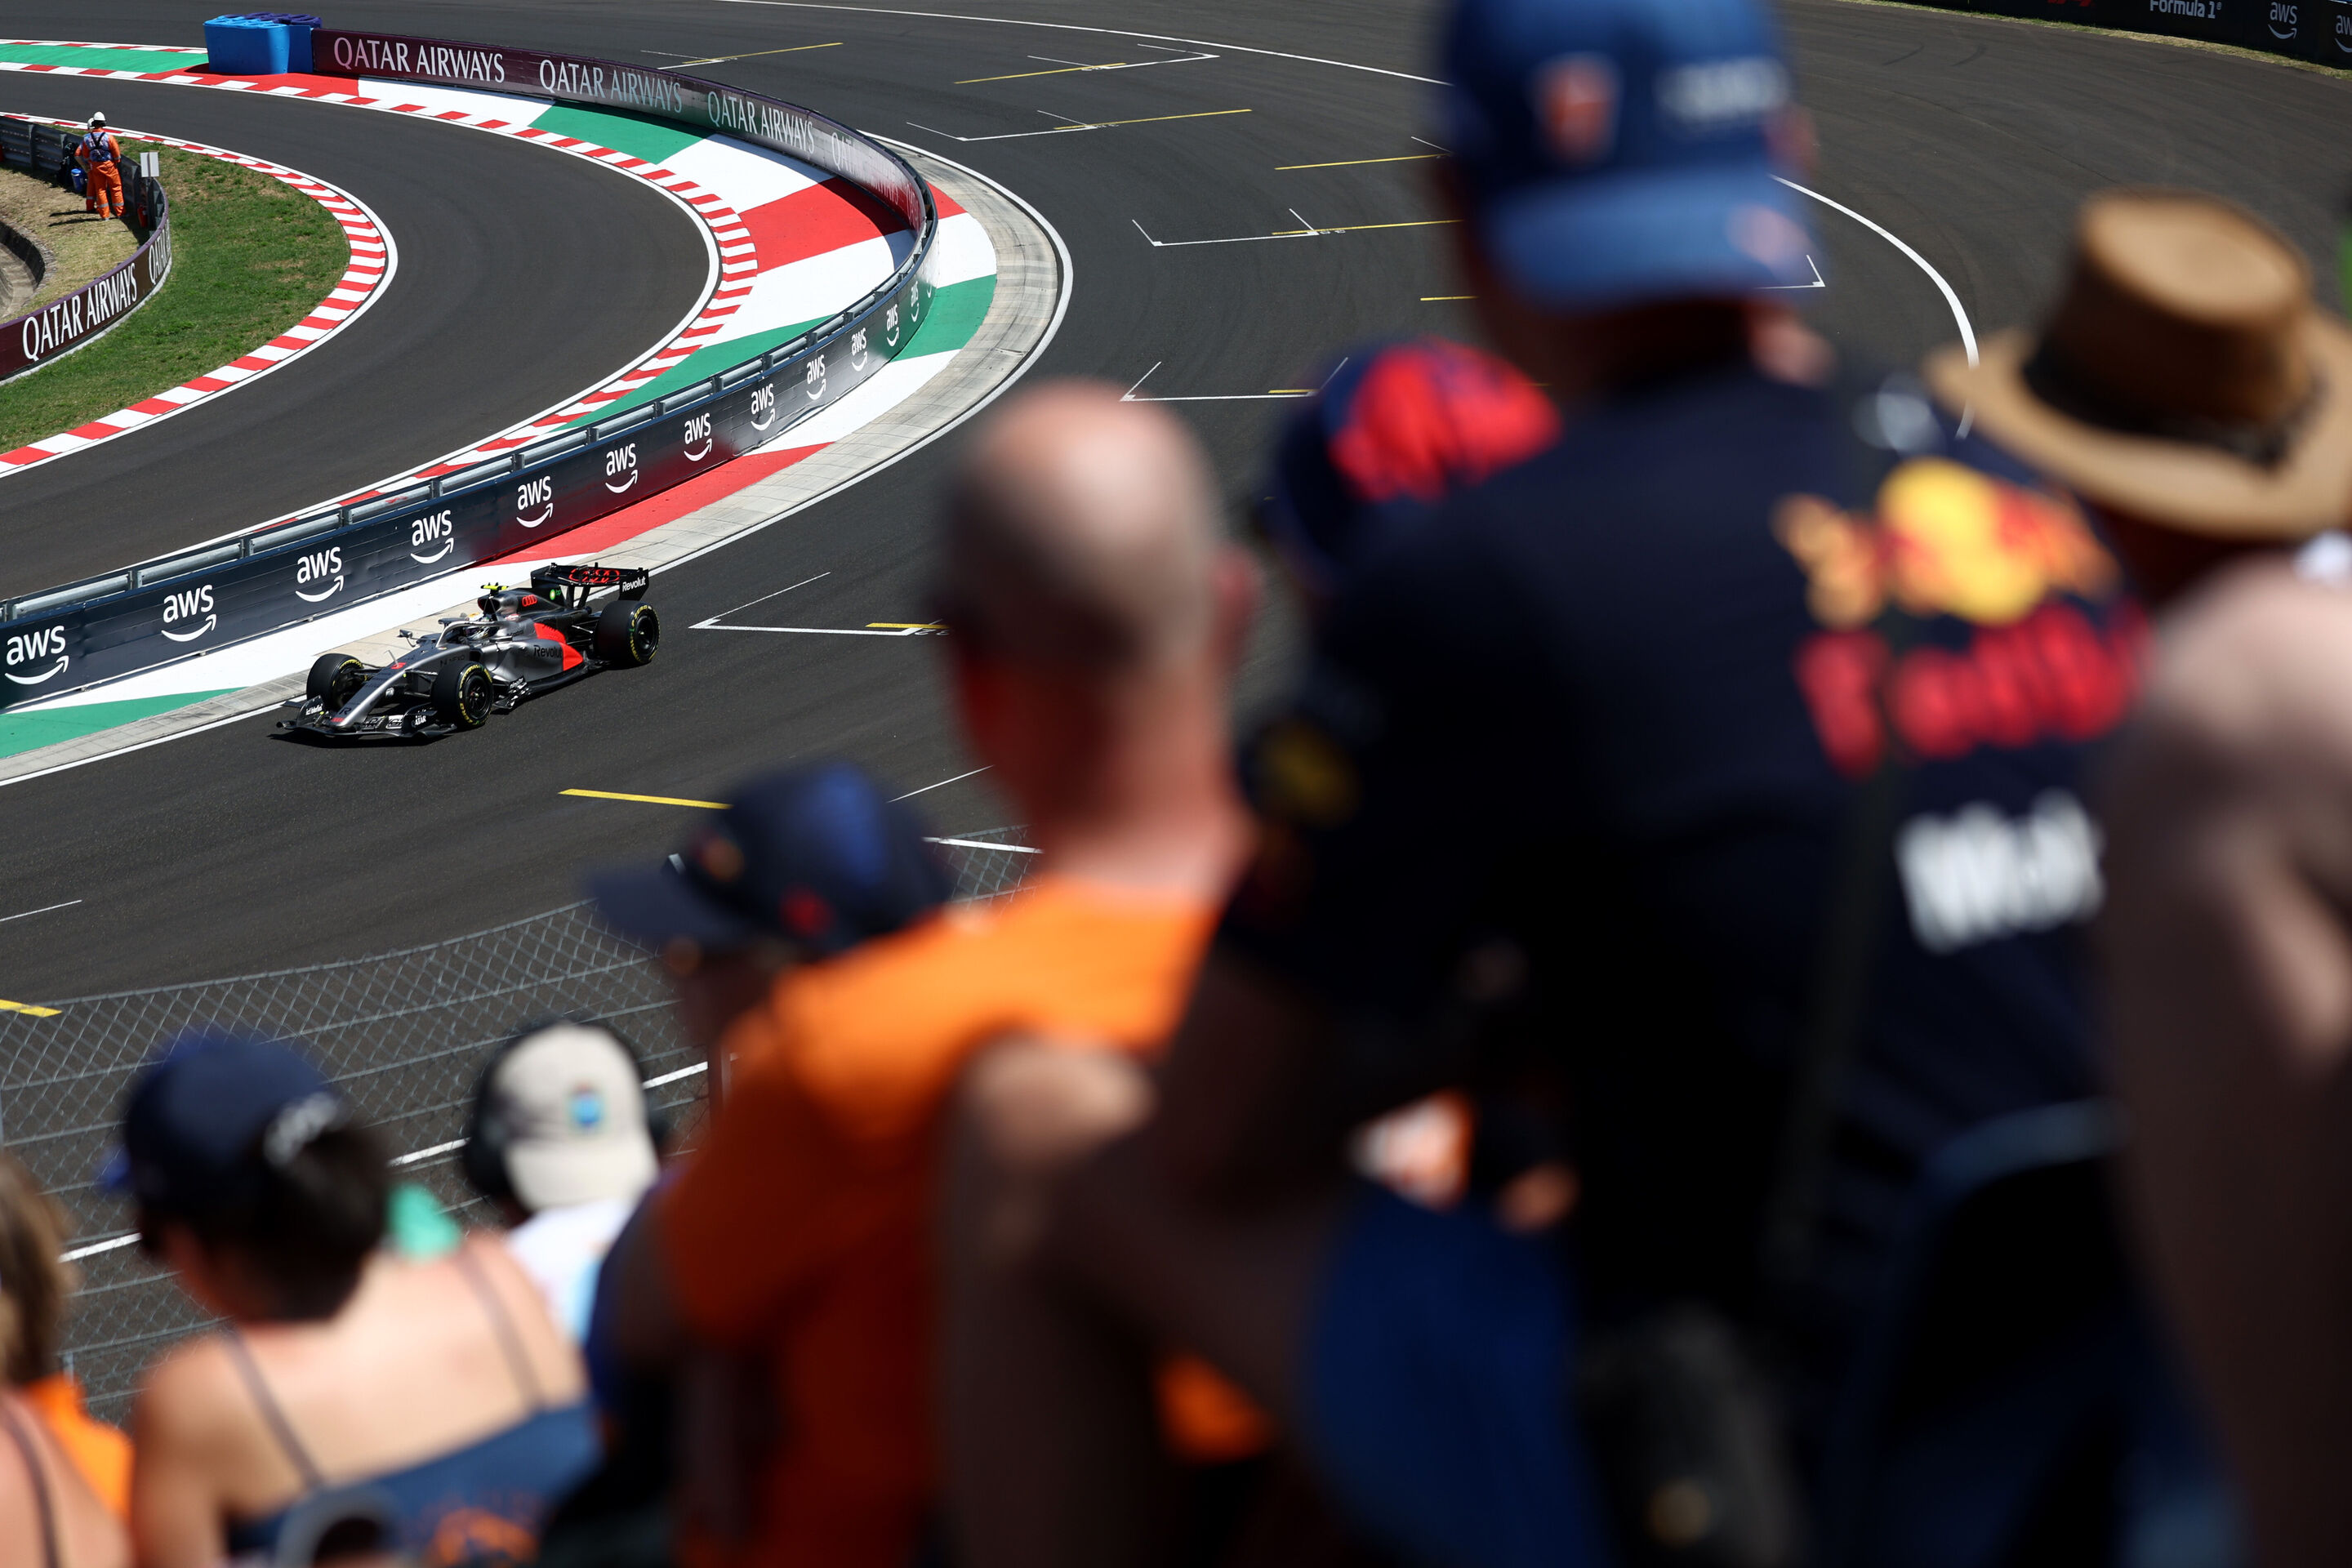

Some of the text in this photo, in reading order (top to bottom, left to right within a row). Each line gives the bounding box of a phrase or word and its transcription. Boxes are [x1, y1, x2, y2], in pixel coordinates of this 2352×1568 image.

[2150, 0, 2205, 17] Formula
[2270, 2, 2297, 24] aws
[2336, 15, 2352, 36] aw
[334, 37, 505, 83] QATAR AIRWAYS
[539, 60, 682, 113] QATAR AIRWAYS
[707, 91, 814, 154] QATAR AIRWAYS
[23, 263, 137, 362] QATAR AIRWAYS
[886, 304, 898, 332] aws
[852, 327, 866, 356] aws
[807, 354, 826, 385] aws
[751, 383, 774, 414] aws
[684, 412, 711, 444] aws
[606, 443, 636, 476] aws
[517, 476, 551, 510] aws
[412, 510, 452, 546] aws
[296, 546, 341, 584] aws
[621, 576, 646, 592] Revolut
[163, 585, 214, 623] aws
[7, 626, 66, 666] aws
[533, 644, 563, 658] Revolut
